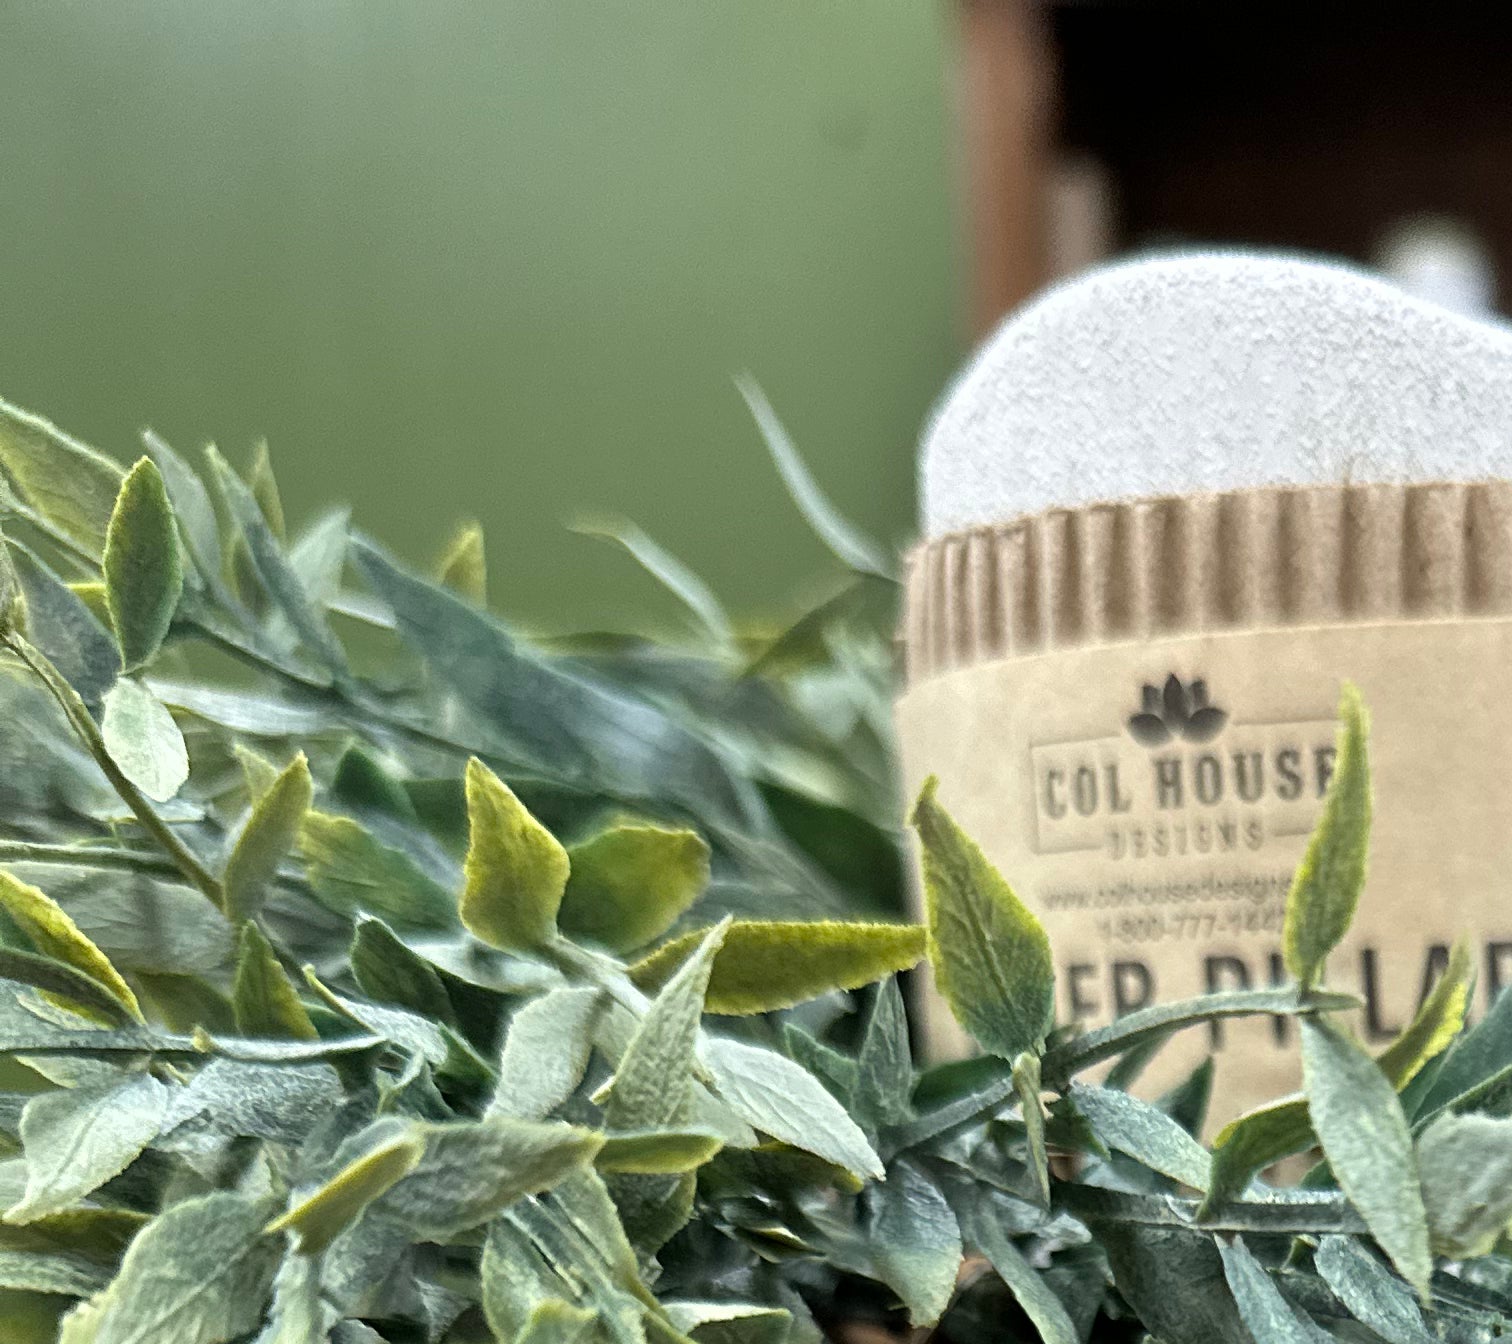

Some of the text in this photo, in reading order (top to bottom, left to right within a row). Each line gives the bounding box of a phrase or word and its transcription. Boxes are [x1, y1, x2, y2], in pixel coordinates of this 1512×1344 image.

[1041, 748, 1337, 820] COL HOUSE
[1107, 818, 1265, 861] DESIGNS
